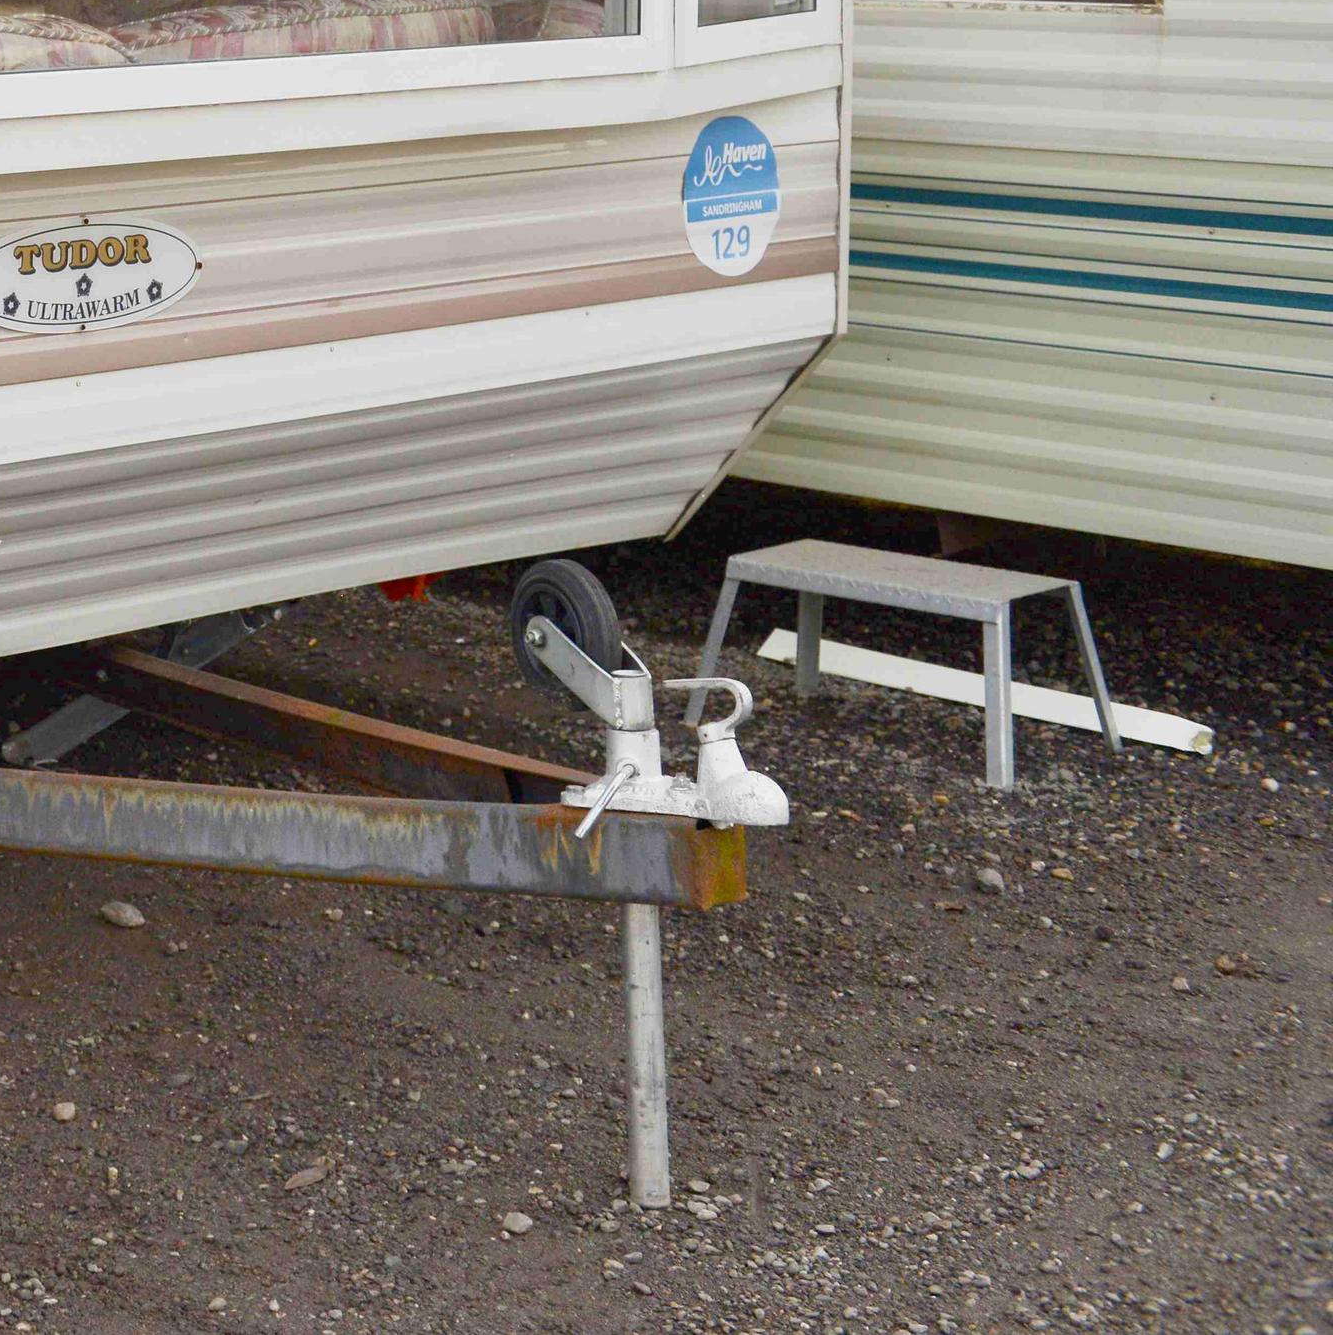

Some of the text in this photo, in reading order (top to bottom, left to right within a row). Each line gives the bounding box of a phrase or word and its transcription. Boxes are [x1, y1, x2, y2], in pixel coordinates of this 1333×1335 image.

[722, 142, 767, 164] Haven
[702, 198, 763, 218] SANDRINGHAM
[13, 233, 152, 275] TUDOR
[711, 224, 751, 260] 129
[27, 287, 142, 321] ULTRAWARM
